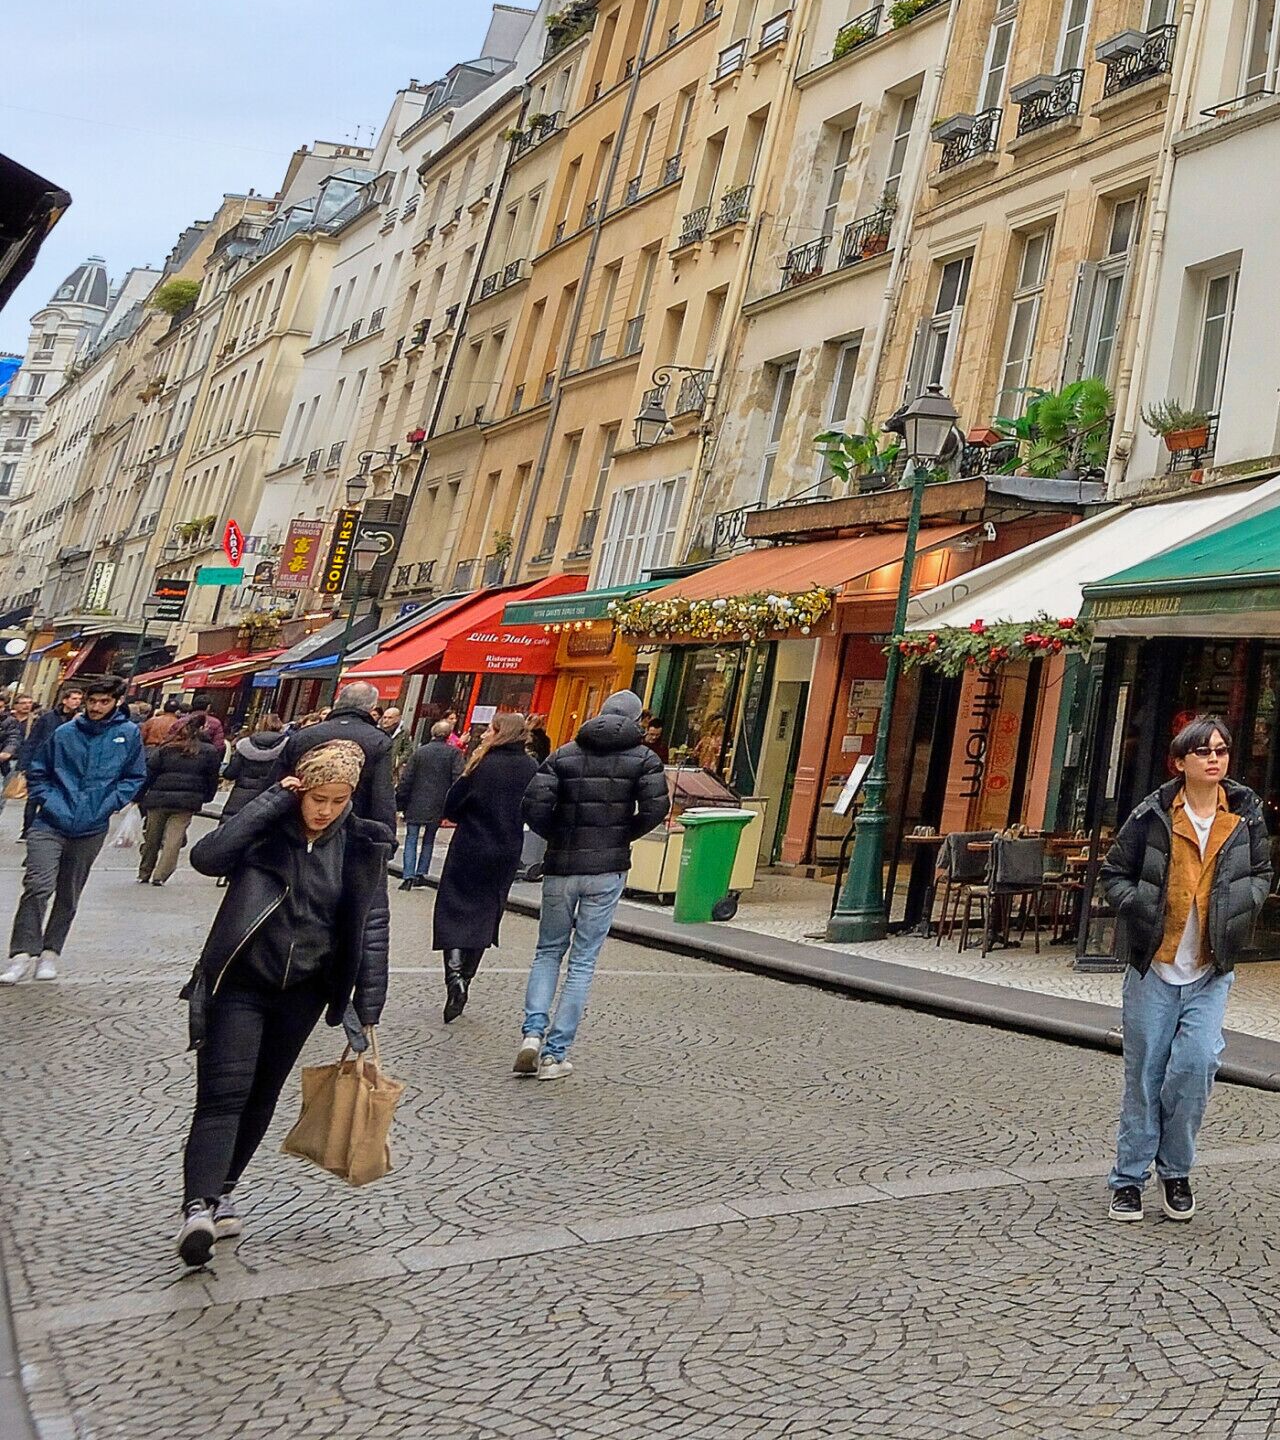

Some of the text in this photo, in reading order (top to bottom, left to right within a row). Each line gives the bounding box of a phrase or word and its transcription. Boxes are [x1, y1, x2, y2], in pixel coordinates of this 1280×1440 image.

[229, 527, 239, 560] TABAC
[466, 632, 498, 643] Little
[501, 633, 533, 647] Italy
